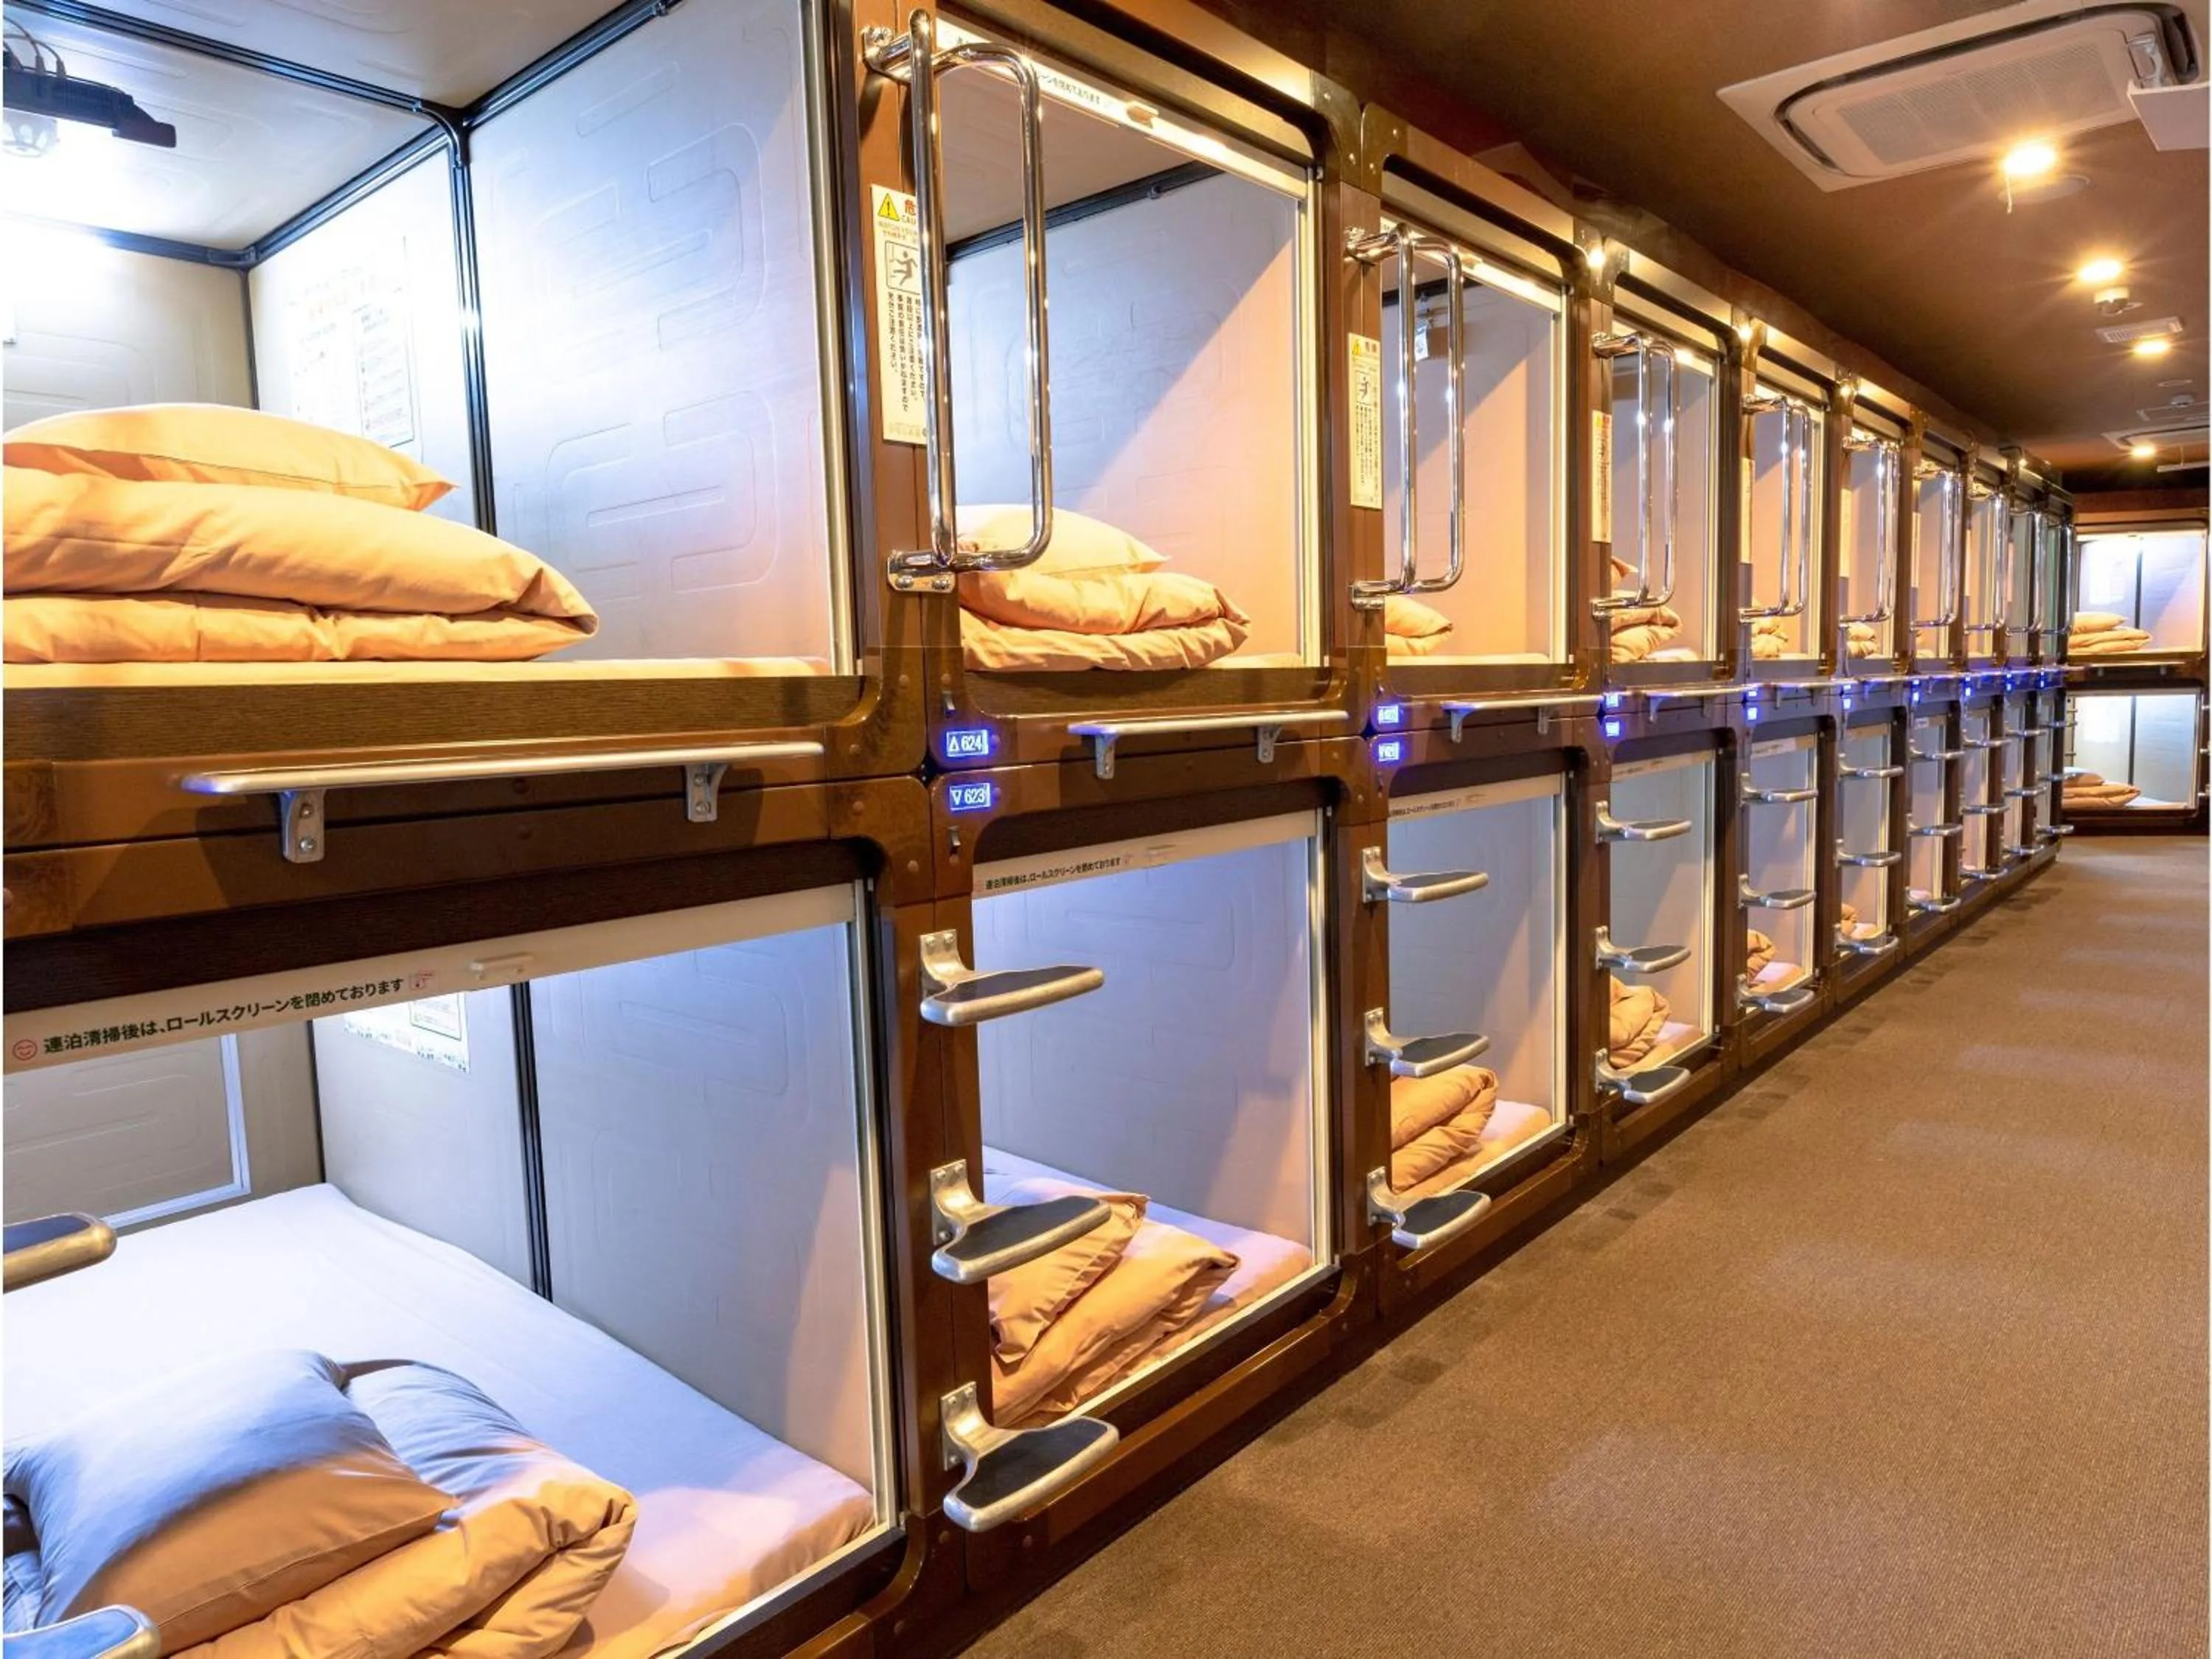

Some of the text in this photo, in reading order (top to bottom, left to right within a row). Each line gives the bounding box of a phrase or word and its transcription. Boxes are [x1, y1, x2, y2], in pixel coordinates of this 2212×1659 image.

[961, 735, 982, 751] 624
[964, 789, 986, 804] 623
[44, 978, 403, 1054] 連泊清掃後は、ロールスクリーンを閉めております
